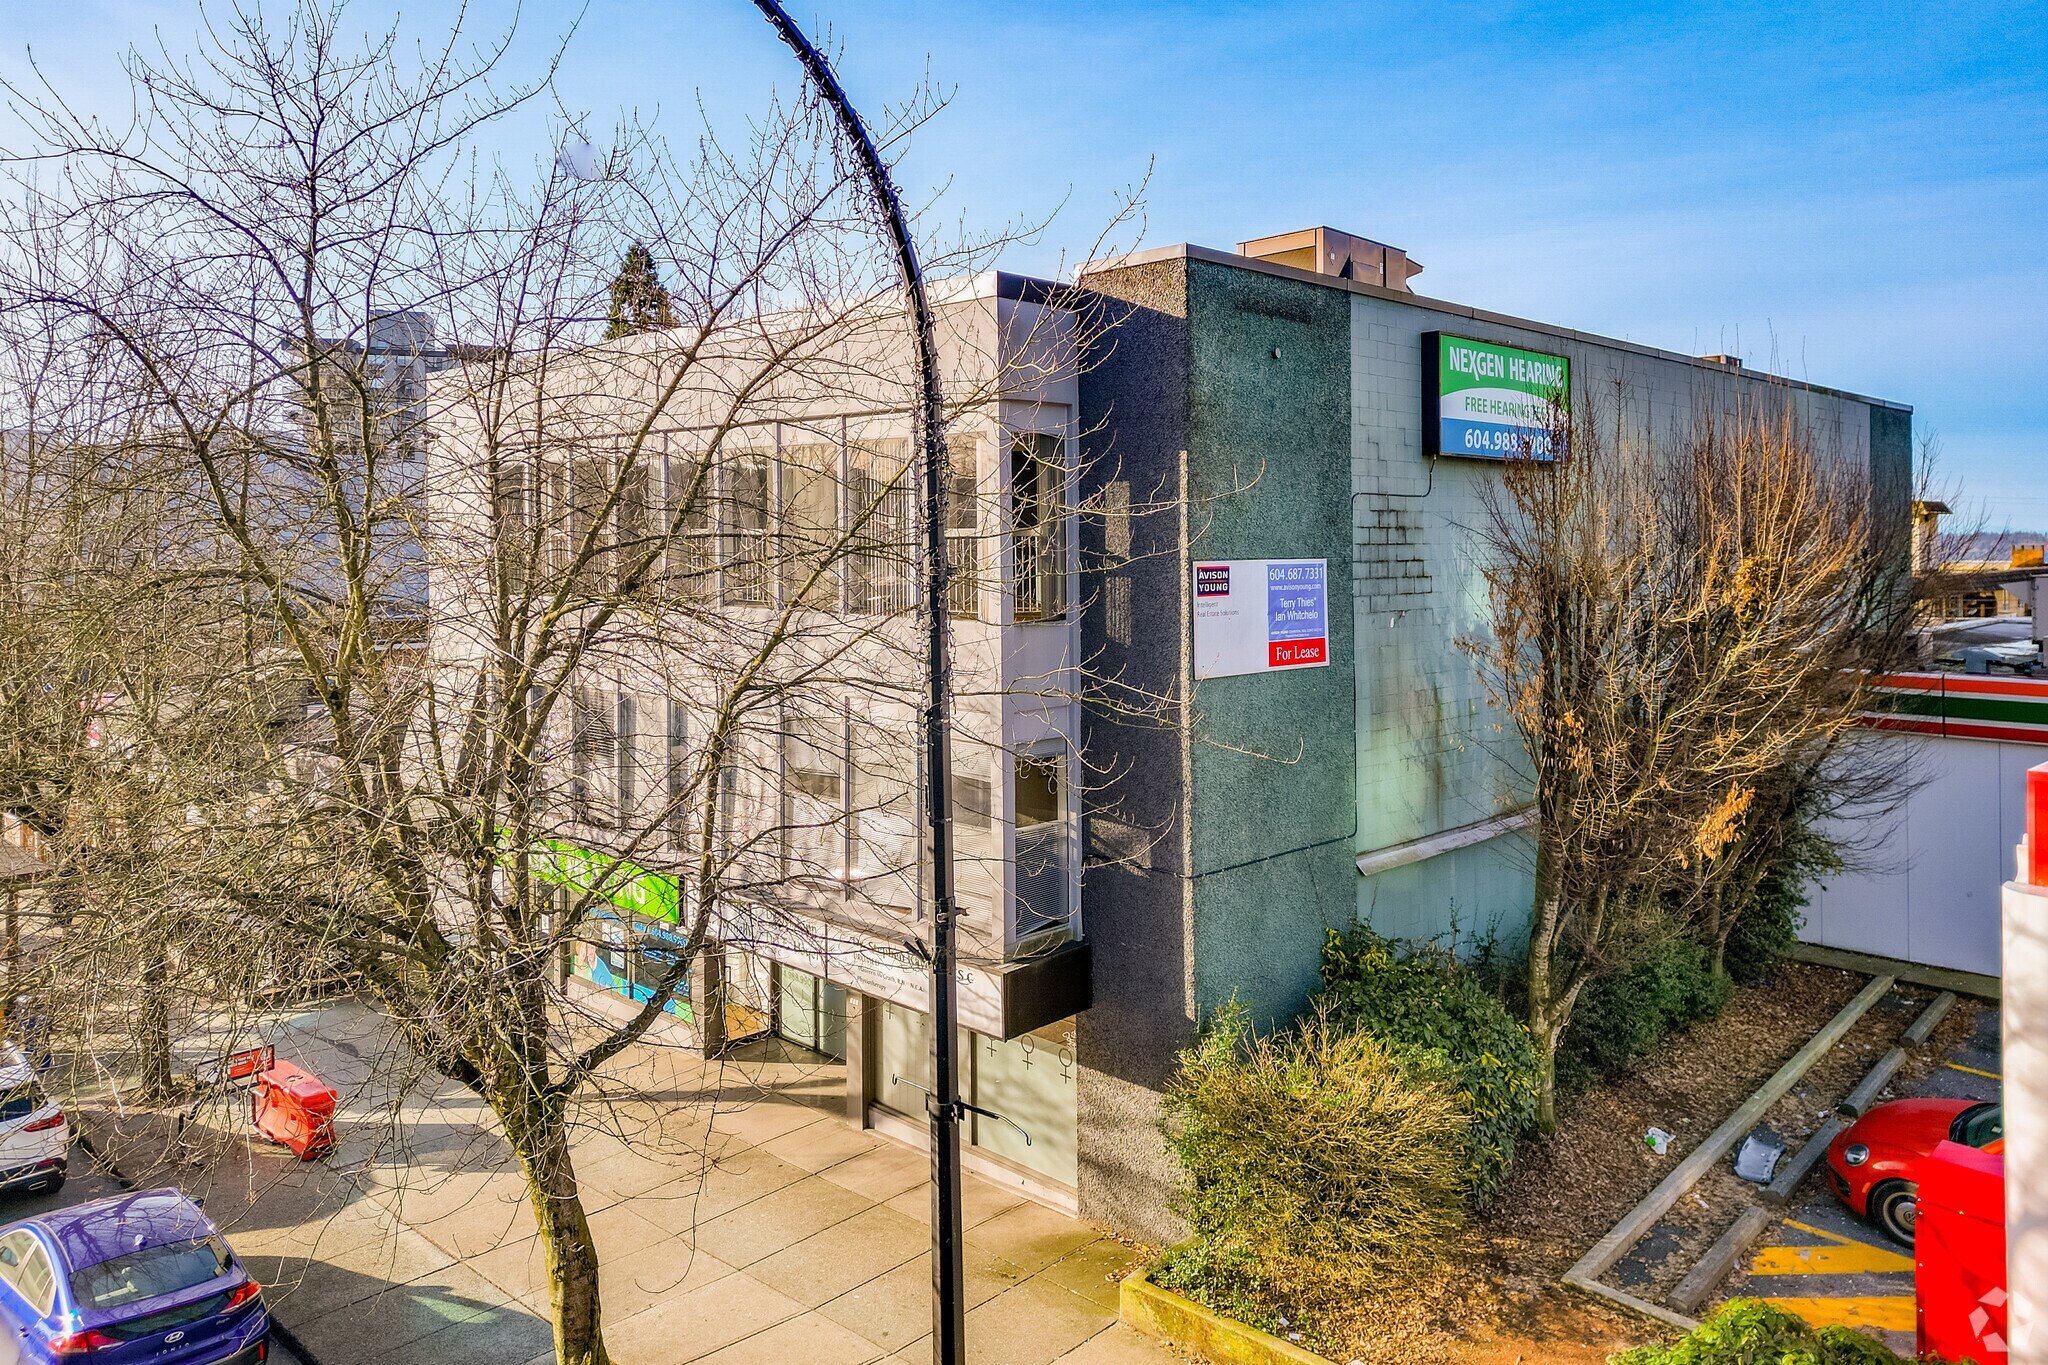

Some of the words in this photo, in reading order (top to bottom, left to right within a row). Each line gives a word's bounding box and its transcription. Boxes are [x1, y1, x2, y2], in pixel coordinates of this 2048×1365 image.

[1449, 346, 1504, 381] NEXGEN
[1509, 357, 1563, 387] HEARING
[1465, 396, 1488, 413] FREE
[1490, 400, 1530, 419] HEARING
[1198, 571, 1229, 580] AVISON
[1269, 567, 1323, 581] 604.687.7331
[1198, 583, 1228, 592] YOUNG
[1279, 597, 1297, 610] Terry
[1276, 646, 1292, 661] For
[1294, 645, 1319, 660] Lease
